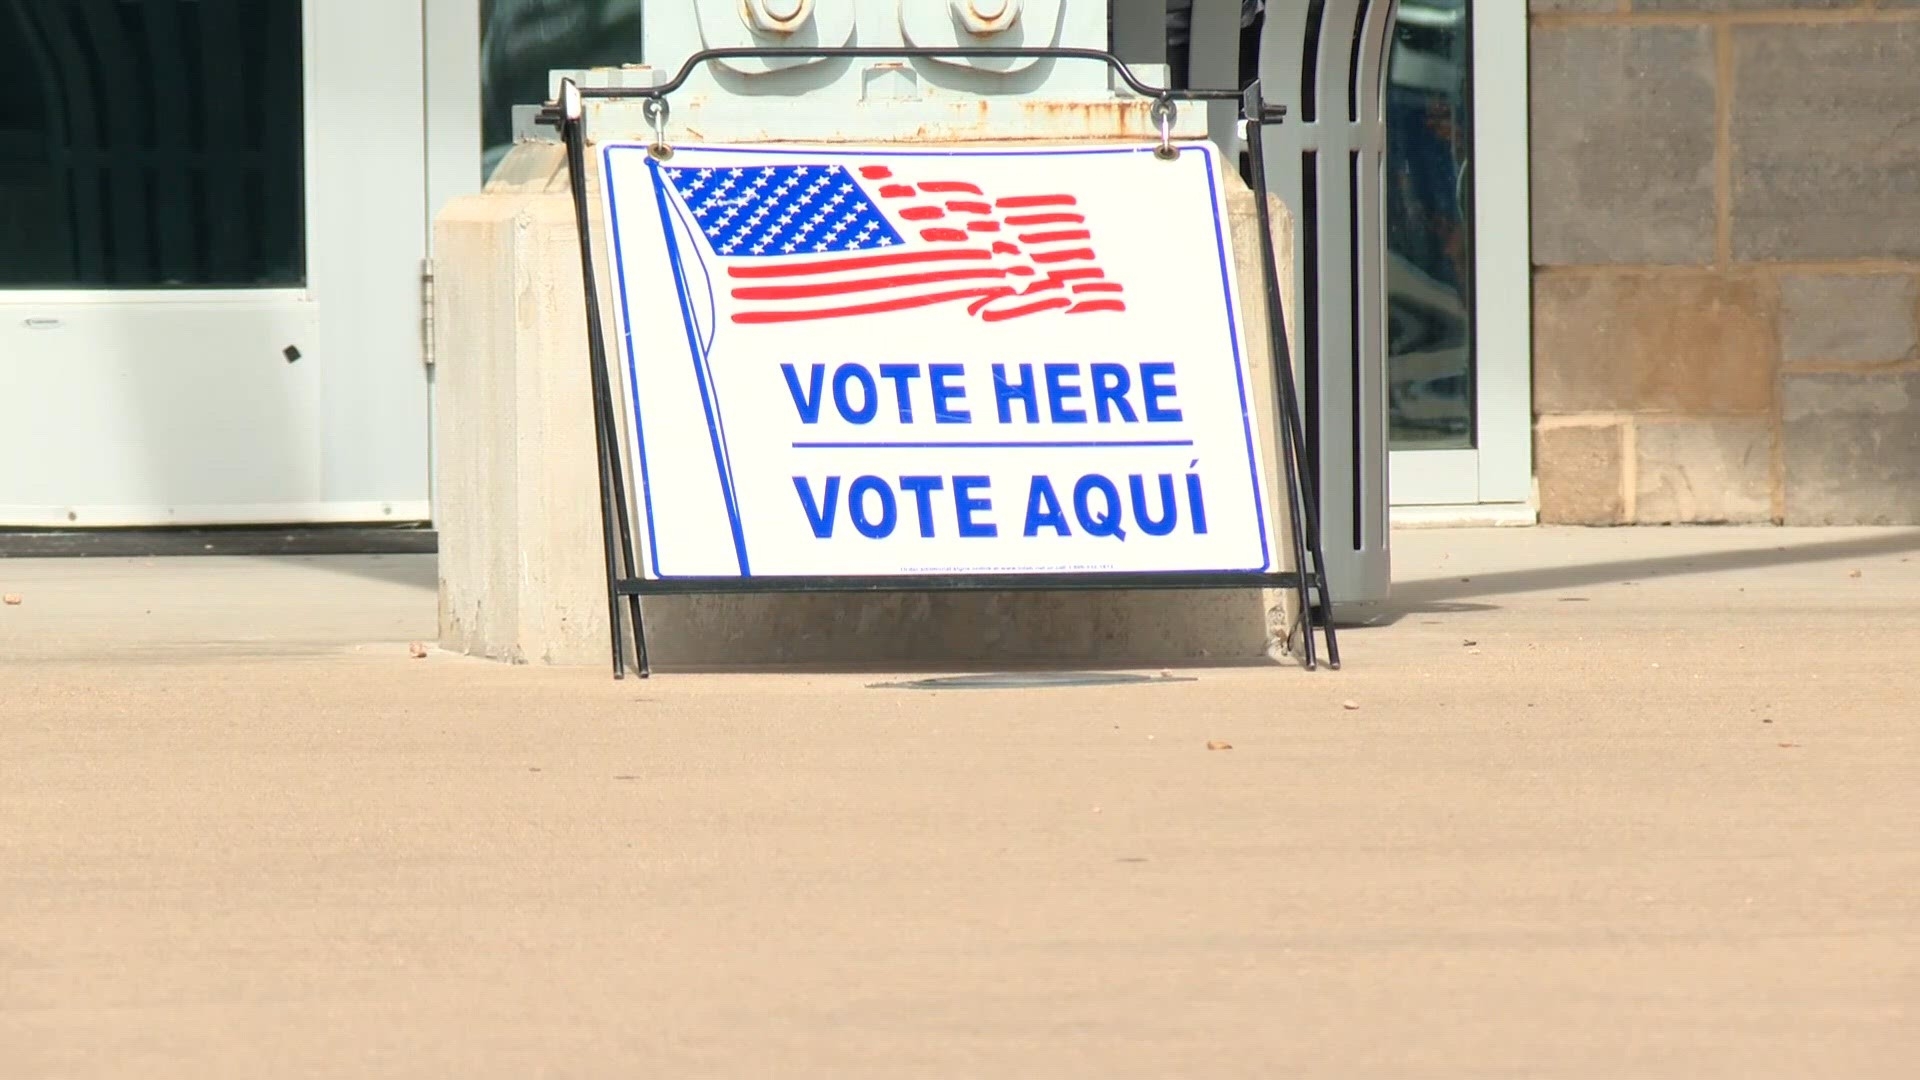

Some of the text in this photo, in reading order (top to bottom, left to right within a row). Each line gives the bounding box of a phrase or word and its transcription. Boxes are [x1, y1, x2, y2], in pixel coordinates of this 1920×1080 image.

[781, 362, 1183, 424] VOTE HERE
[793, 458, 1208, 541] VOTE AQUÍ
